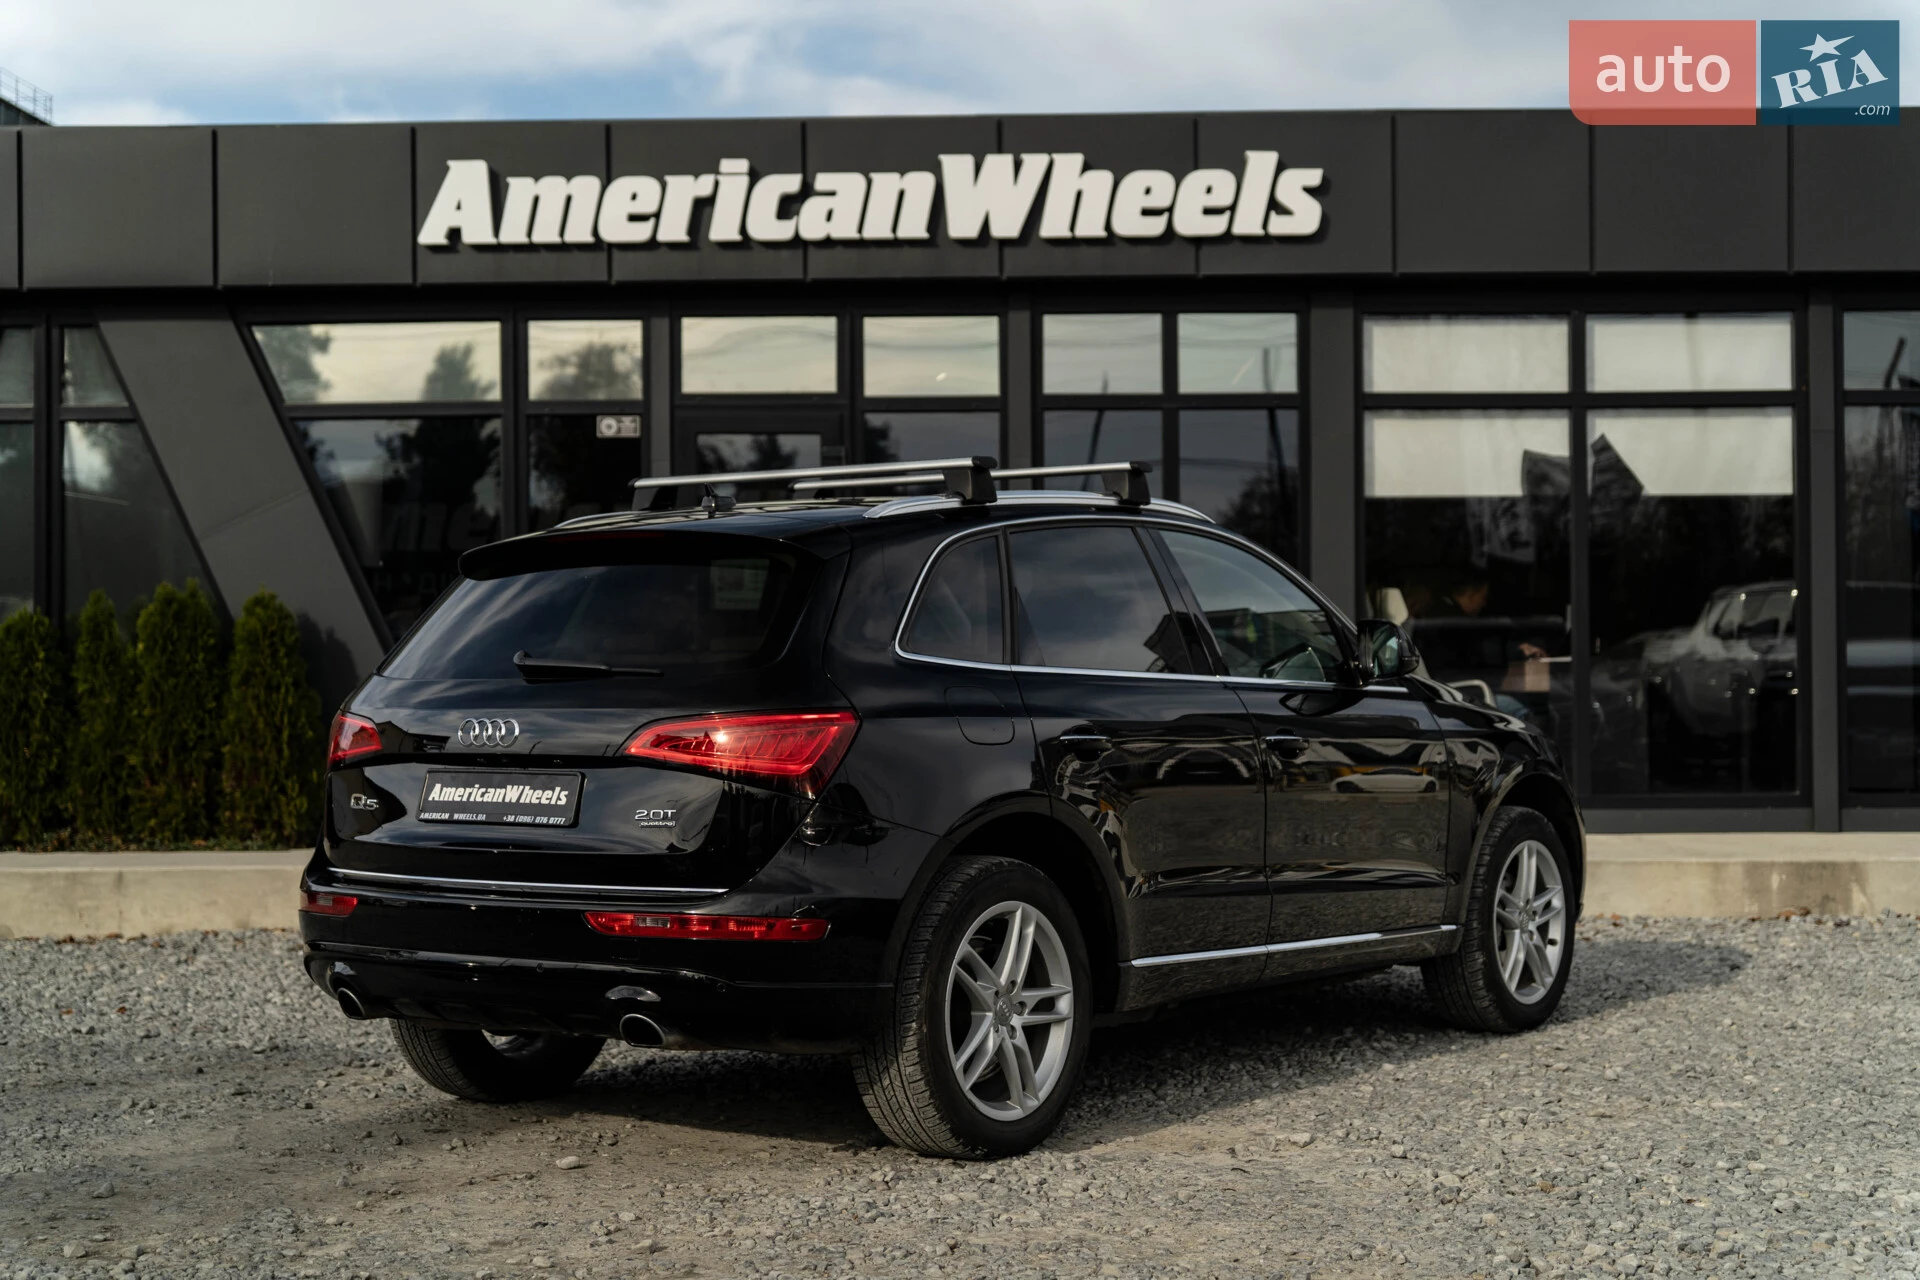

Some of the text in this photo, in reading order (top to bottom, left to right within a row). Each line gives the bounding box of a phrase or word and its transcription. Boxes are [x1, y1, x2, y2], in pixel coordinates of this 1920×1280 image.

[416, 149, 1325, 247] AmericanWheels
[350, 793, 379, 810] Q5
[428, 783, 569, 805] AmericanWheels
[419, 812, 450, 820] AMERICAN
[453, 813, 487, 821] WHEELS.UA
[503, 814, 515, 822] +38
